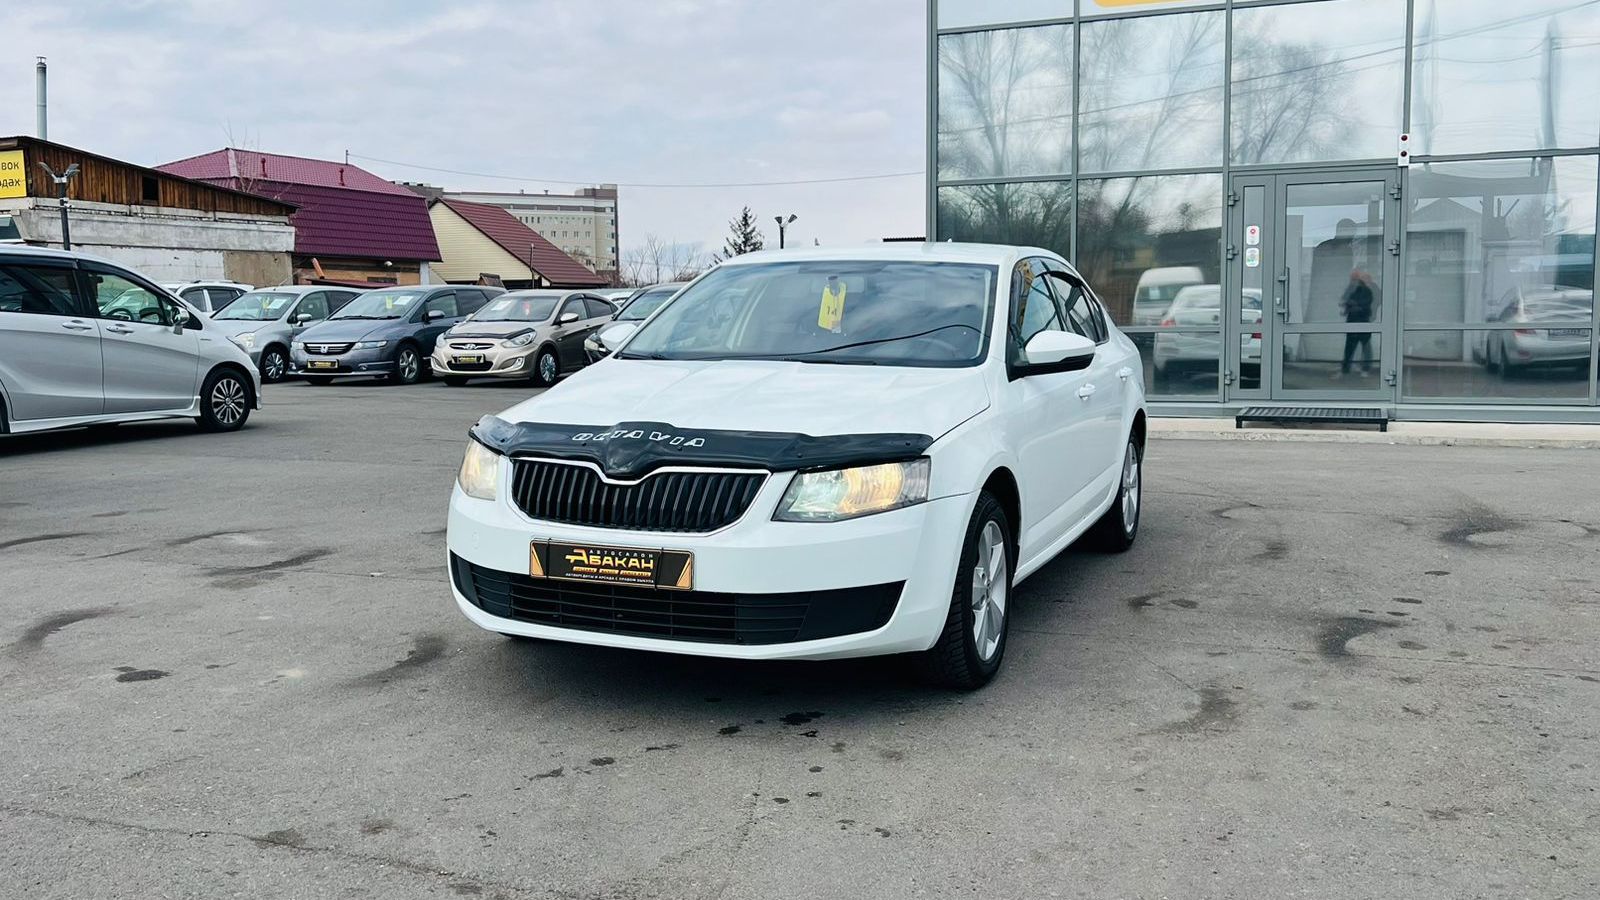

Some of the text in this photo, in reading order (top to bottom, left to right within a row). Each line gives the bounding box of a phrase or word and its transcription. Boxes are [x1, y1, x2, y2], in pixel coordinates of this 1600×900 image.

[572, 430, 705, 447] OCTAVIA
[565, 549, 654, 569] АБАКАН
[589, 550, 653, 558] АВТОСАЛОН
